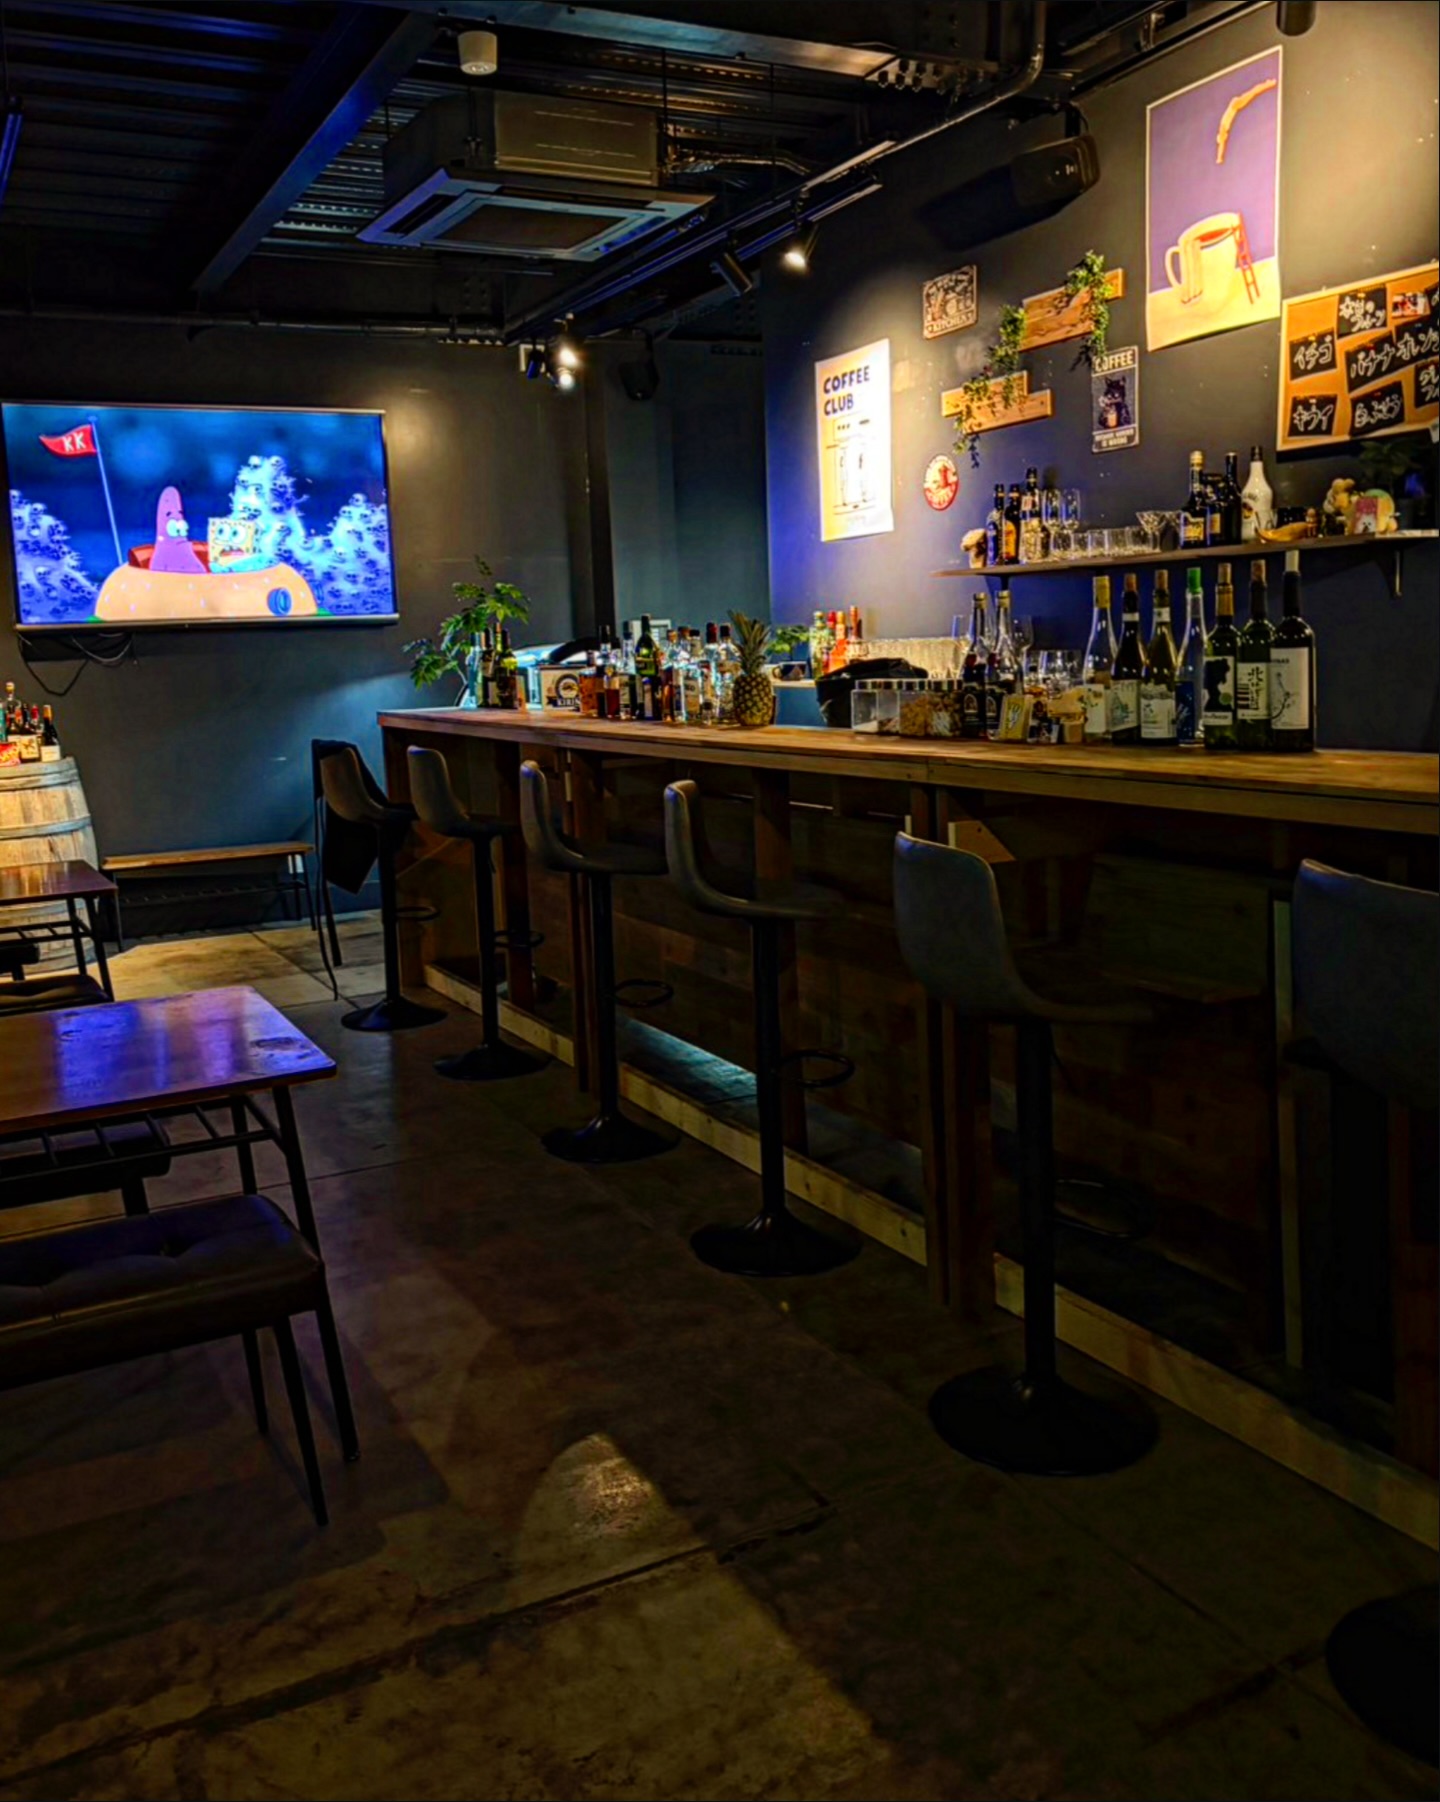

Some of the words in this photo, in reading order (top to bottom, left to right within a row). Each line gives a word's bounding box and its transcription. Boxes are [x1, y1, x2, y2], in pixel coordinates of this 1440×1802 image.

[1094, 350, 1133, 371] COFFEE
[1294, 335, 1332, 370] イチゴ
[823, 365, 870, 394] COFFEE
[823, 393, 854, 416] CLUB
[1293, 404, 1334, 431] キウイ
[62, 432, 87, 453] KK
